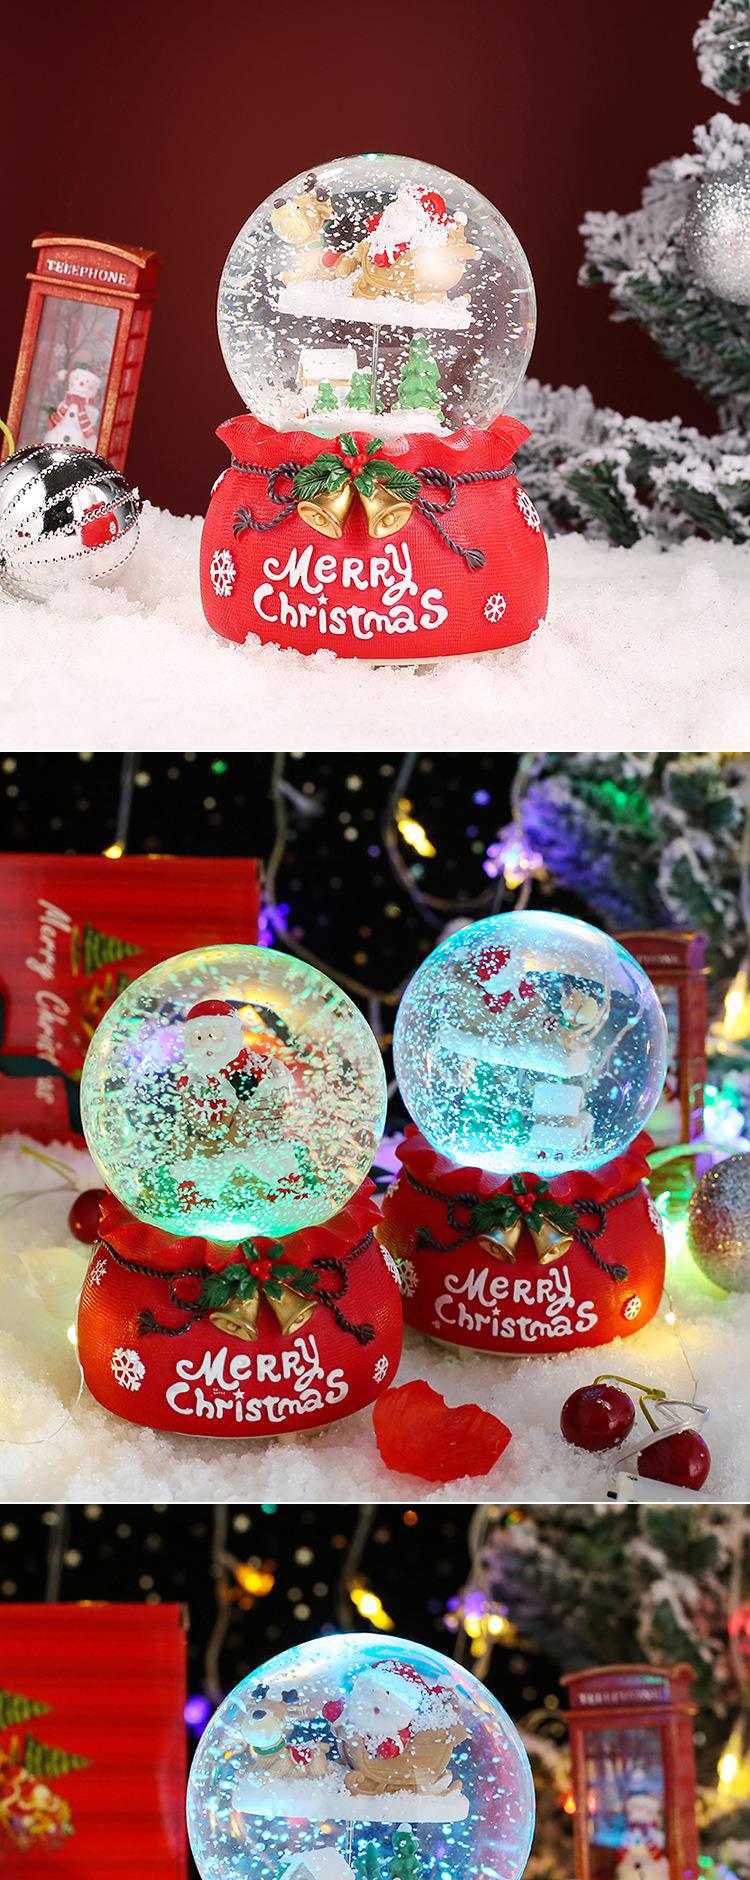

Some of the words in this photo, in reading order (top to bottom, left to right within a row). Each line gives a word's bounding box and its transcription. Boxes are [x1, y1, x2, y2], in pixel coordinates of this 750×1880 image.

[46, 259, 128, 285] TELEPHONE
[25, 898, 72, 980] Merry
[35, 990, 71, 1104] Christas
